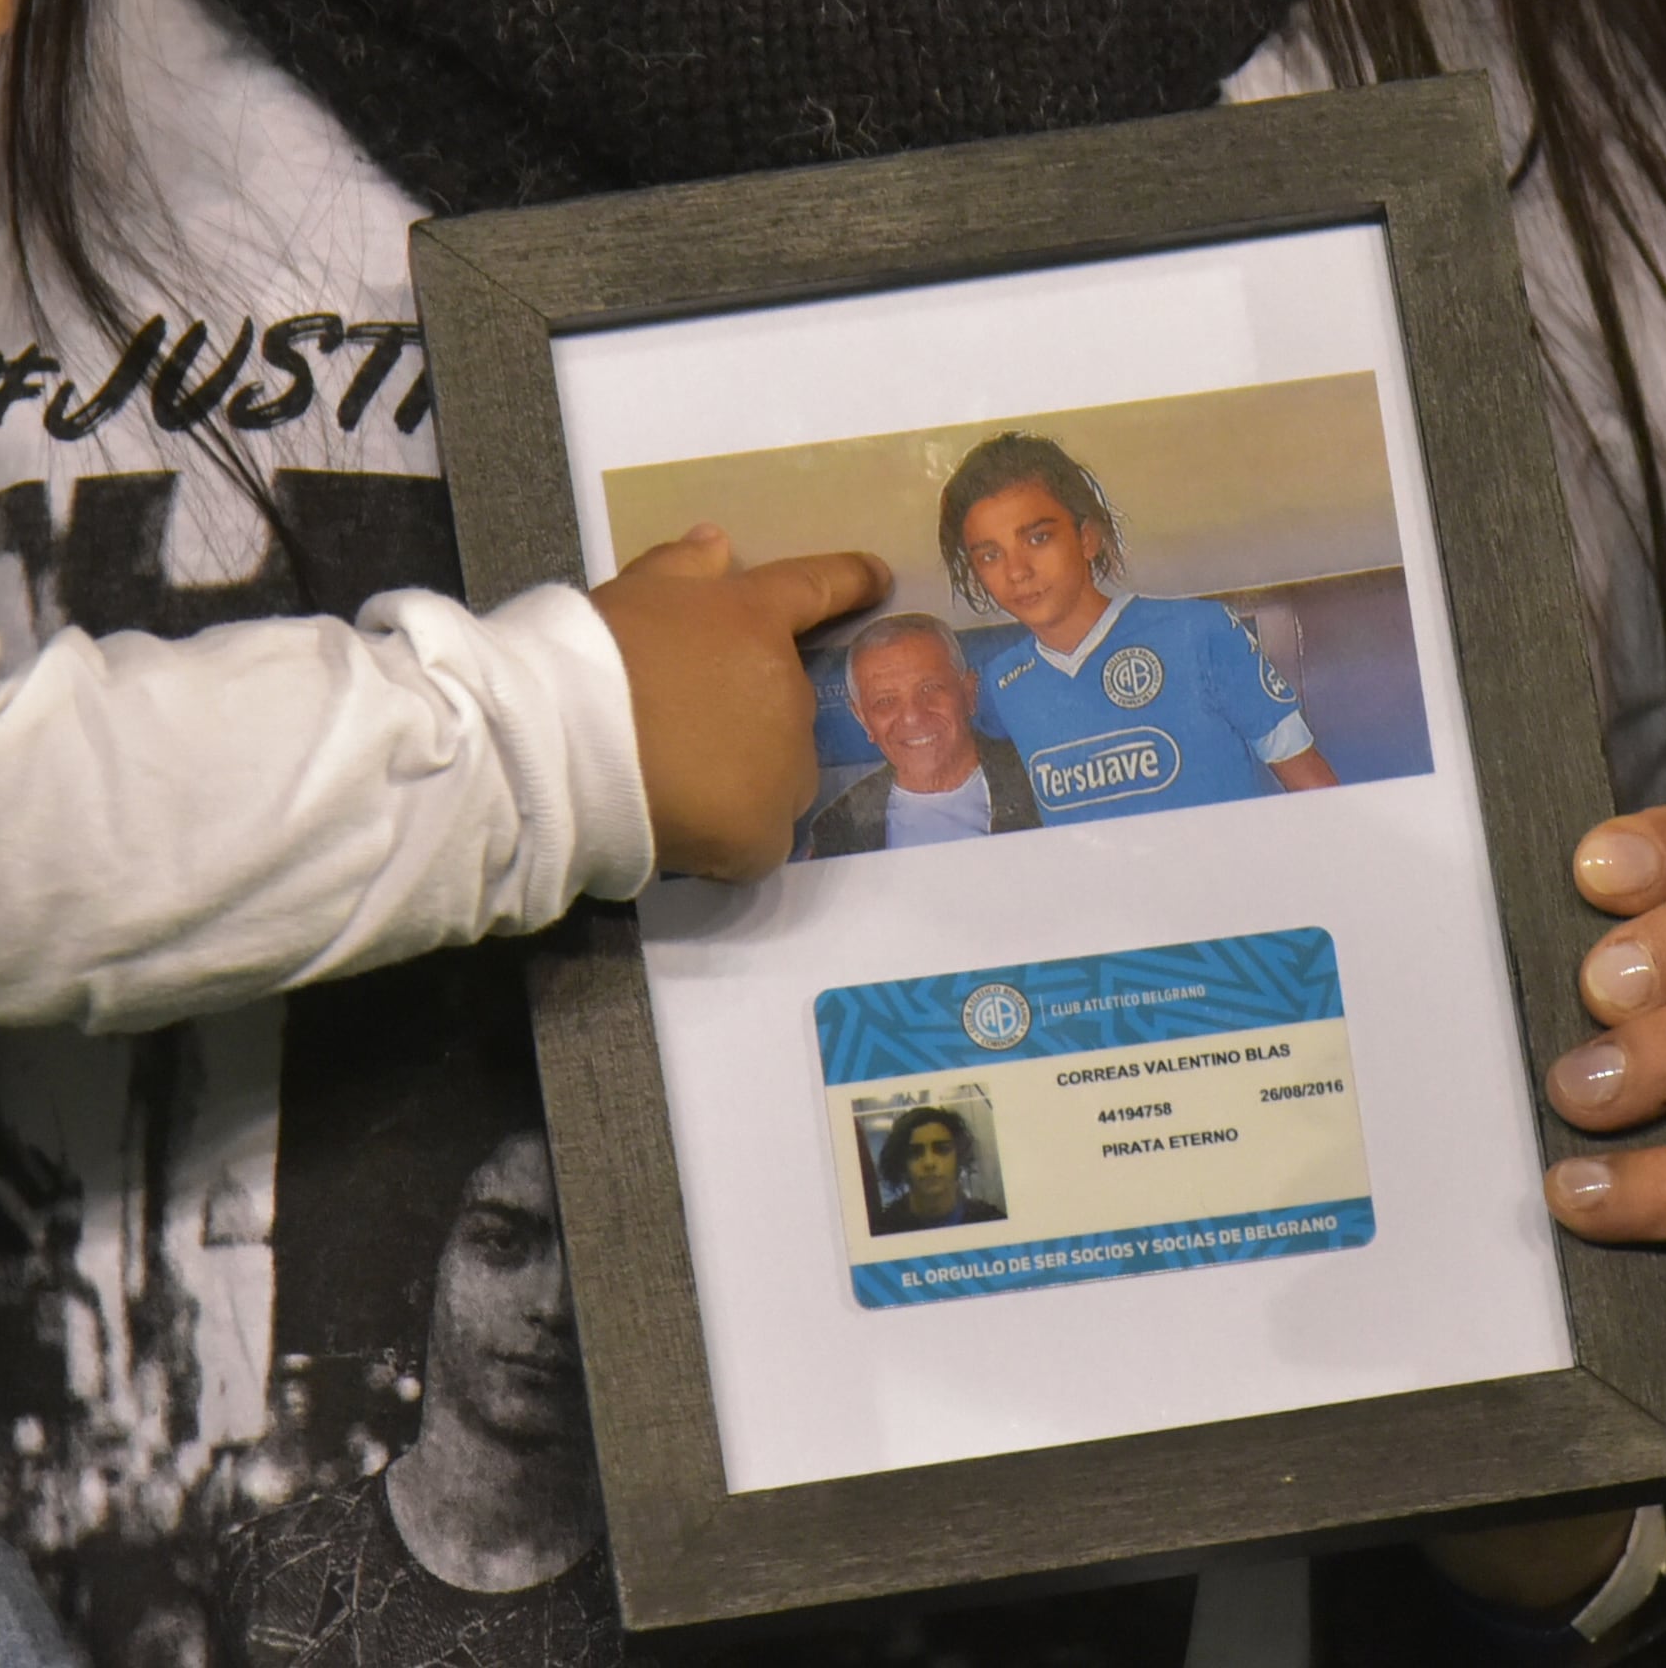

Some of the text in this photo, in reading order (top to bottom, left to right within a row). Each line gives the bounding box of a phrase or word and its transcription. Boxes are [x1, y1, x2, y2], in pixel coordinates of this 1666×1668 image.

[1036, 745, 1160, 798] Tersuave
[1050, 984, 1206, 1017] CLUB ATLETICO BELGRANO
[1056, 1042, 1291, 1087] CORREAS VALENTINO BLAS
[1259, 1078, 1344, 1103] 26/08/2016
[1097, 1101, 1173, 1124] 44194758
[1101, 1127, 1239, 1158] PIRATA ETERNO
[900, 1215, 1338, 1288] EL ORGULLO DE SER SOCIOS Y SOCIAS DE BELGRANO
